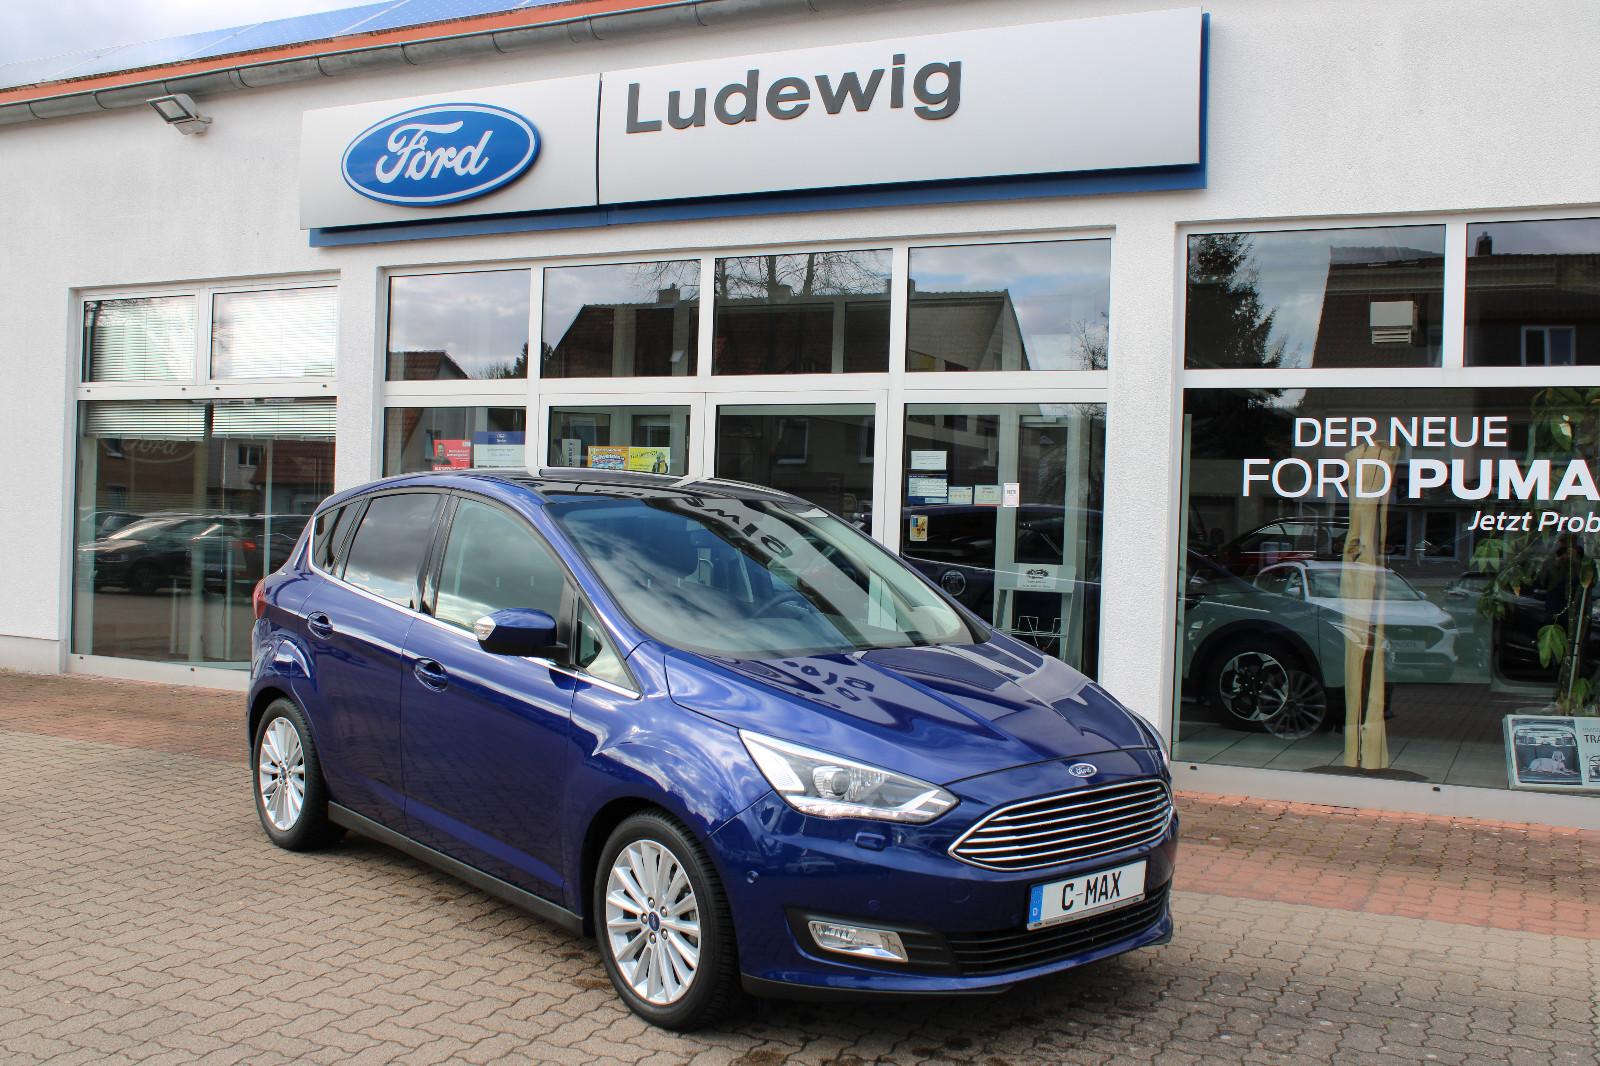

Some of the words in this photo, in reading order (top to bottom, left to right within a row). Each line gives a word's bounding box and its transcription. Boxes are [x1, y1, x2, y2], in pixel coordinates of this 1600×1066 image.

[625, 53, 963, 134] Ludewig
[375, 121, 492, 185] Ford
[1294, 417, 1377, 447] DER
[1390, 416, 1509, 447] NEUE
[1243, 457, 1393, 498] FORD
[1408, 458, 1600, 501] PUMA
[1468, 510, 1532, 532] Jetzt
[1538, 511, 1600, 533] Prob
[1061, 870, 1122, 911] C-MAX
